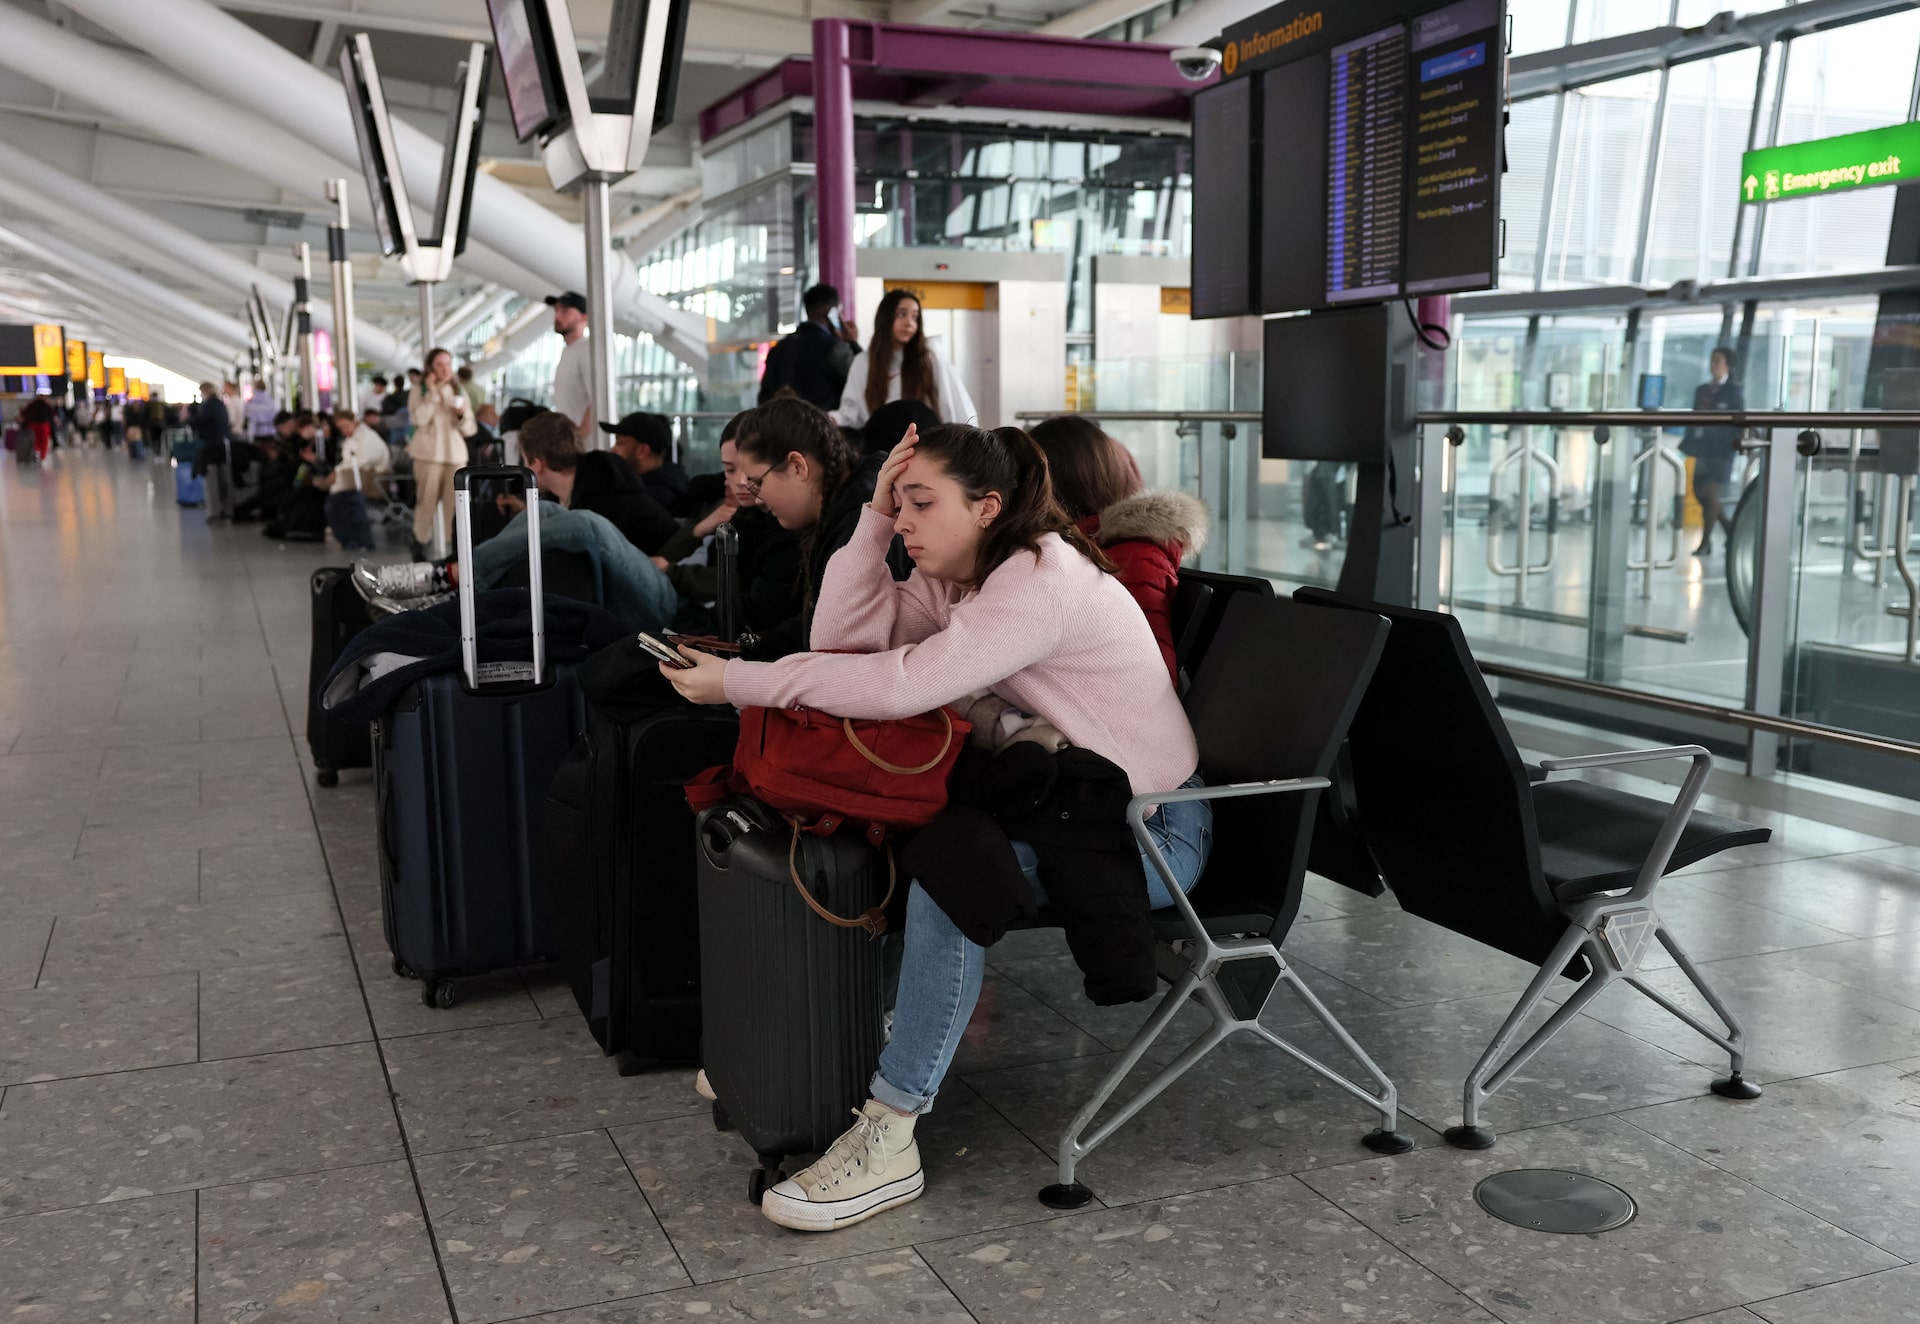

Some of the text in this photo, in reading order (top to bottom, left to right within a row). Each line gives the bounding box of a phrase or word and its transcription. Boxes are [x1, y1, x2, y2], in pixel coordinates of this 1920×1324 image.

[1241, 11, 1322, 61] Information
[1783, 155, 1901, 191] Emergency exit
